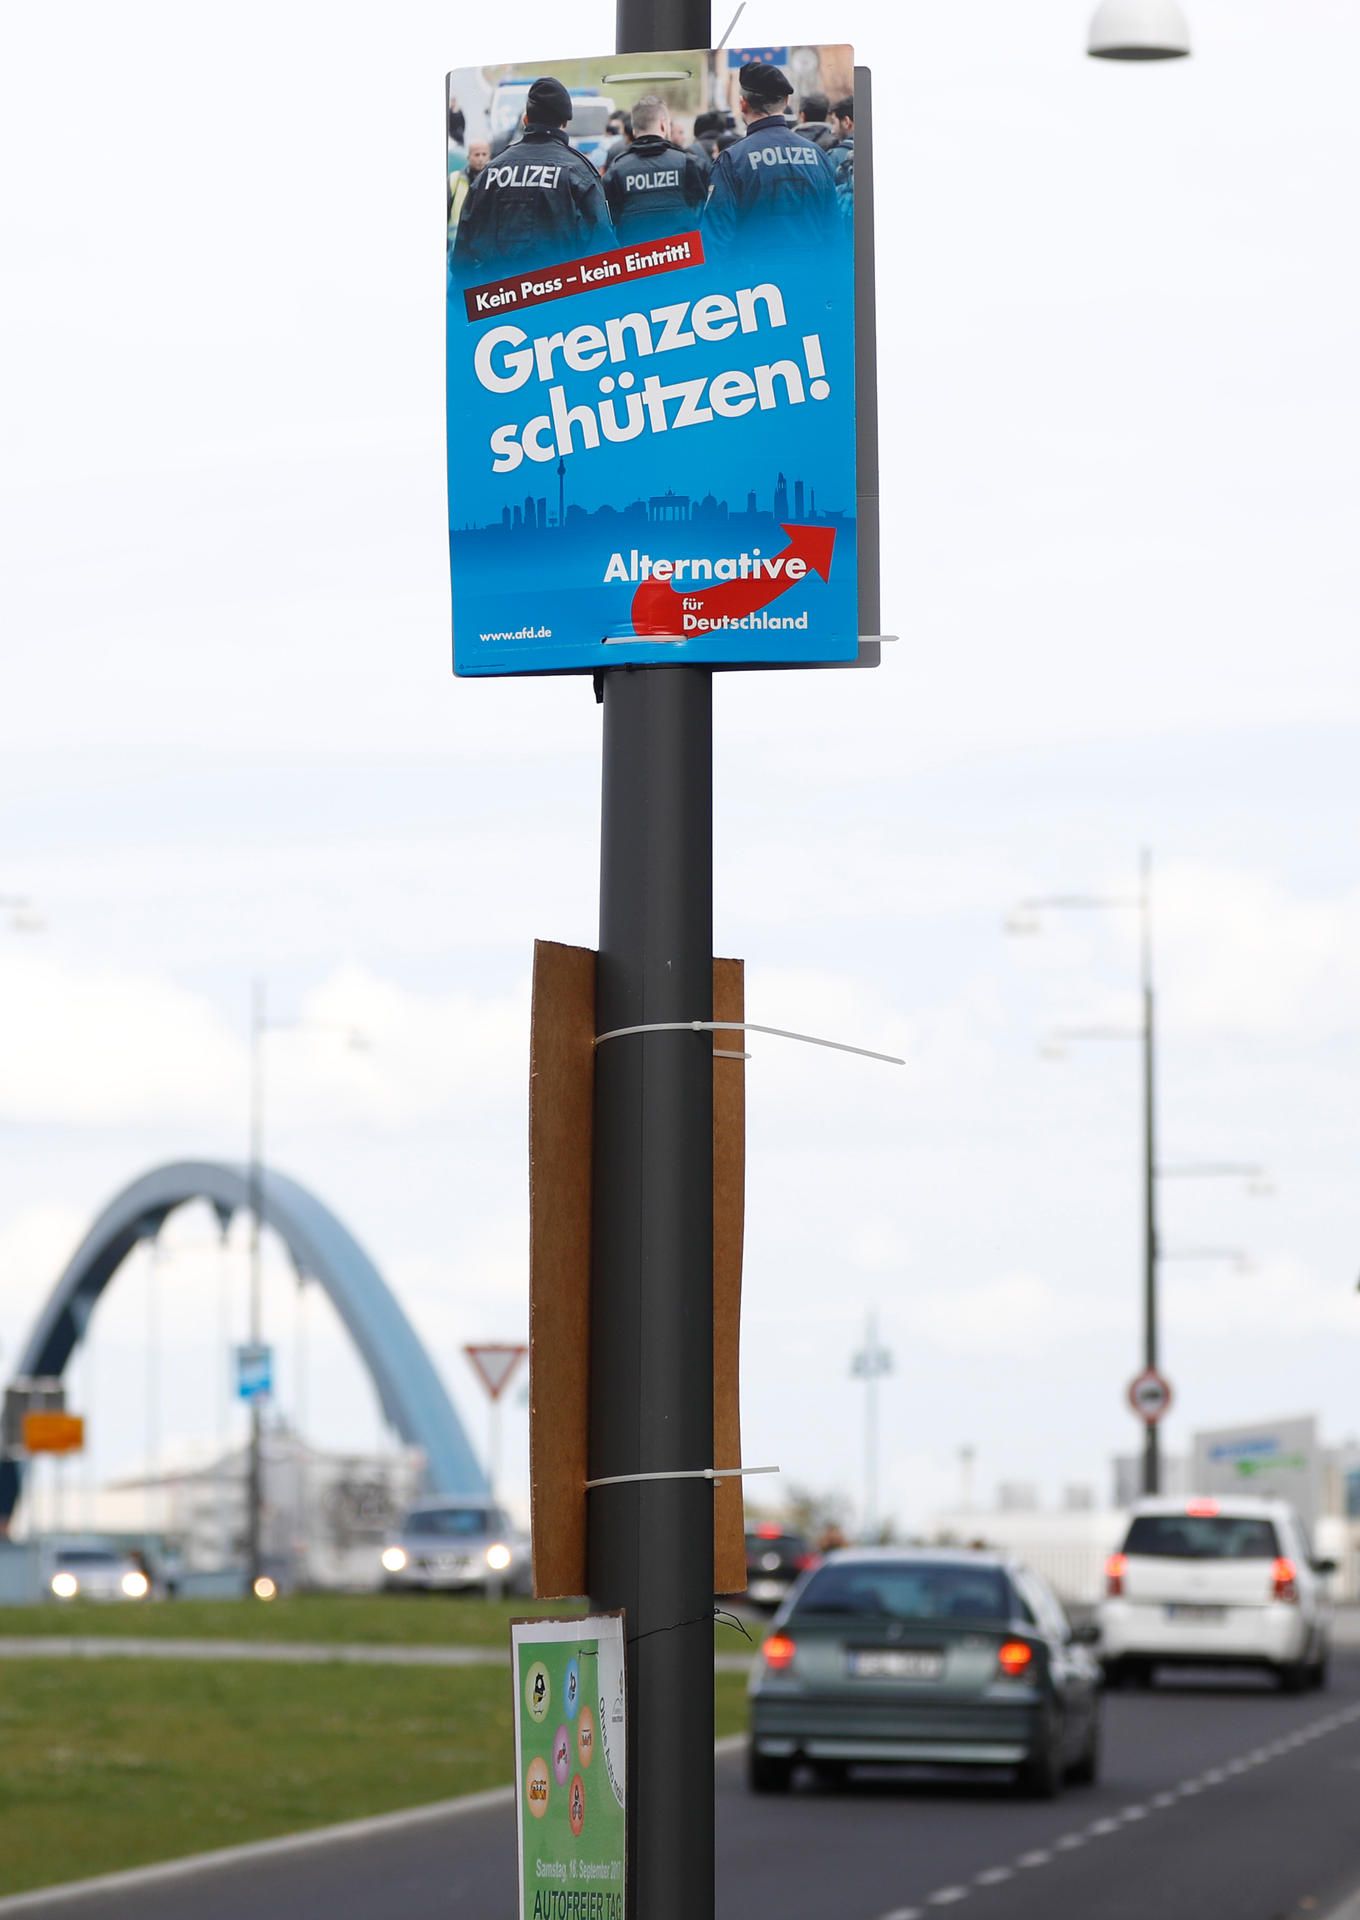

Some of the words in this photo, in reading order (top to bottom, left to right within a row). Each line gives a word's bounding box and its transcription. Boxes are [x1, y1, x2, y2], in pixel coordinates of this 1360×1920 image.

[748, 146, 819, 171] POLIZEI
[485, 165, 562, 190] POLIZEI
[625, 170, 680, 192] POLIZEI
[475, 284, 517, 313] Kein
[520, 275, 563, 301] Pass
[580, 259, 621, 284] kein
[625, 242, 691, 273] Eintritt!
[473, 282, 788, 395] Grenzen
[489, 334, 831, 473] schützen!
[603, 549, 808, 583] Alternative
[682, 597, 704, 611] für
[682, 612, 808, 631] Deutschland
[479, 627, 552, 643] www.afd.de
[536, 1858, 567, 1883] Samstag,
[579, 1859, 610, 1883] September
[533, 1889, 604, 1920] AUTOFREIER
[605, 1892, 622, 1920] TAG
